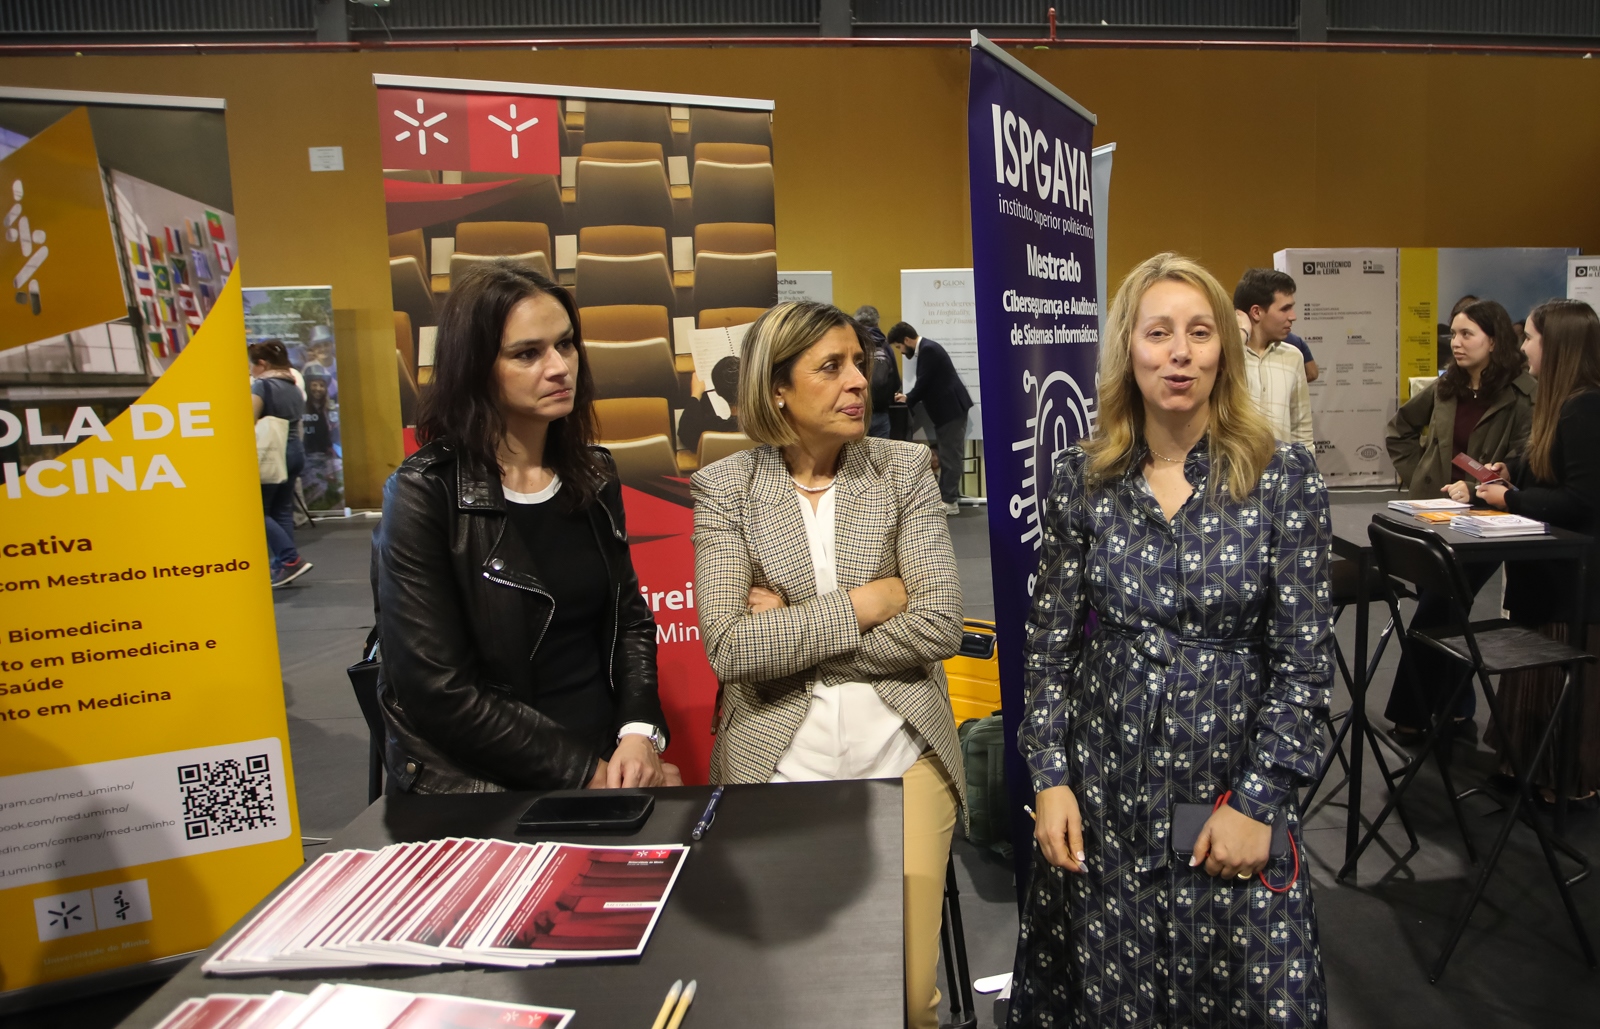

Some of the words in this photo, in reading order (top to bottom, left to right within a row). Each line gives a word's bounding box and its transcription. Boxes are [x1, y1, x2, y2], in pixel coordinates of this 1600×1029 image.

[991, 103, 1092, 217] ISPGAYA
[999, 193, 1034, 222] instituto
[1034, 209, 1061, 231] superior
[1062, 216, 1094, 240] politécnico
[1026, 243, 1082, 283] Mestrado
[1002, 289, 1063, 320] Cibersegurança
[1064, 300, 1070, 315] e
[1070, 296, 1098, 316] Auditoria
[1010, 322, 1024, 346] de
[1023, 323, 1054, 345] Sistemas
[1054, 323, 1098, 344] Informáticos
[0, 406, 114, 448] OLA
[129, 401, 215, 441] DE
[3, 453, 187, 500] ICINA
[0, 535, 93, 559] cativa
[47, 567, 147, 589] Mestrado
[153, 558, 251, 579] Integrado
[640, 581, 694, 612] irei
[8, 618, 144, 644] Biomedicina
[655, 622, 700, 645] Min
[0, 660, 25, 673] to
[30, 655, 65, 669] em
[71, 639, 200, 665] Biomedicina
[205, 638, 218, 649] e
[0, 676, 65, 697] Saúde
[37, 702, 72, 717] em
[78, 690, 172, 712] Medicina
[0, 820, 176, 856] din.com/company/med-uminho
